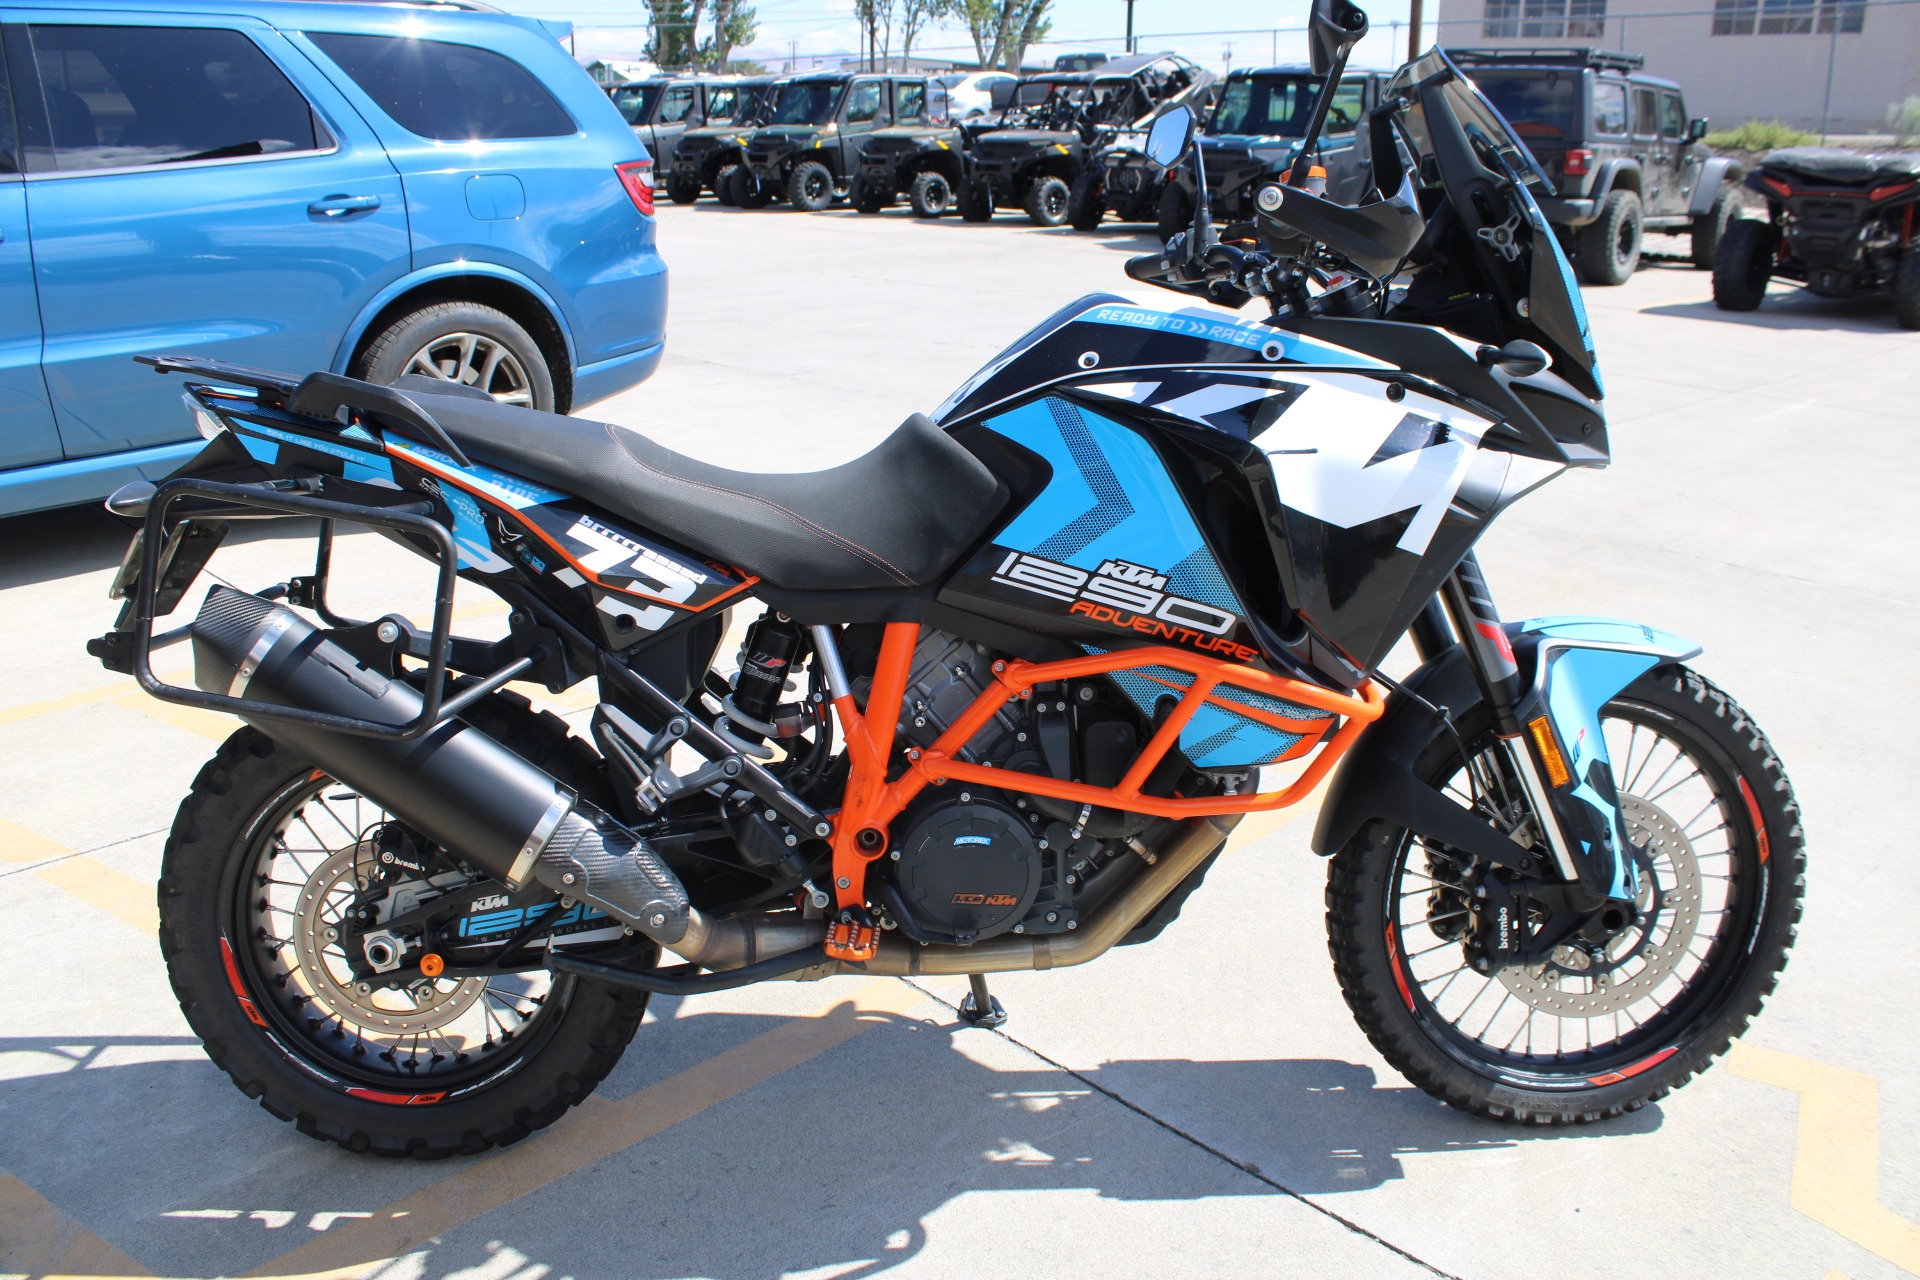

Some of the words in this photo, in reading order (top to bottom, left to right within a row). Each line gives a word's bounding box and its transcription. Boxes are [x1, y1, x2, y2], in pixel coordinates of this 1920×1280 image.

[1097, 309, 1158, 326] READY
[1162, 316, 1186, 330] TO
[1207, 326, 1262, 346] RACE
[265, 428, 284, 439] RIDE
[286, 434, 295, 442] IT
[295, 436, 312, 448] LIKE
[313, 442, 329, 453] YOU
[330, 447, 356, 460] STOLE
[356, 455, 366, 463] IT
[991, 551, 1237, 635] 1290
[1097, 560, 1169, 591] KTM
[1069, 600, 1259, 662] ADVENTURE
[954, 836, 990, 846] MOTOREX
[470, 894, 510, 913] KTM
[985, 894, 1018, 906] KTM
[1498, 906, 1509, 950] brembo
